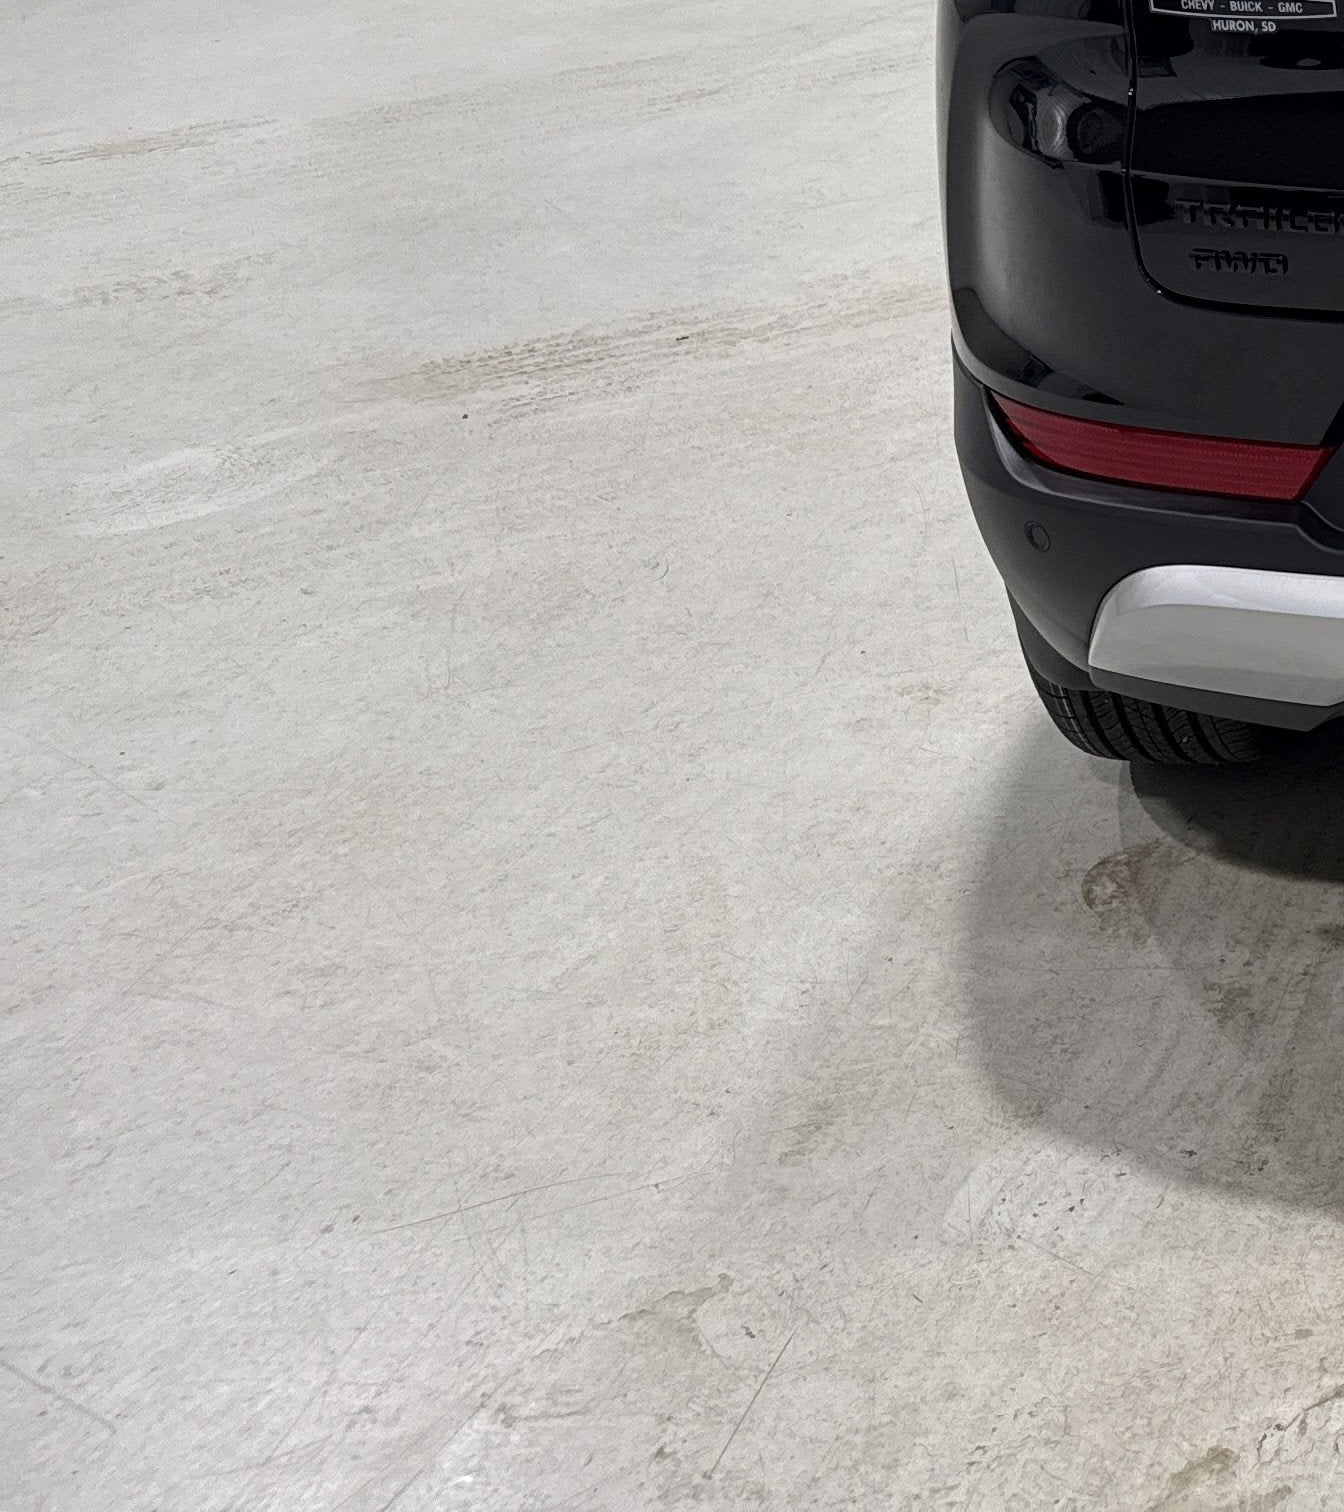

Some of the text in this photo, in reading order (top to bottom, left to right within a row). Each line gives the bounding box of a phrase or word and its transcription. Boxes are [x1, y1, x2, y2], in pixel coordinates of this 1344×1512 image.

[1230, 0, 1263, 13] BUICK
[1278, 2, 1303, 14] GMC
[1212, 19, 1277, 34] HURON, SD
